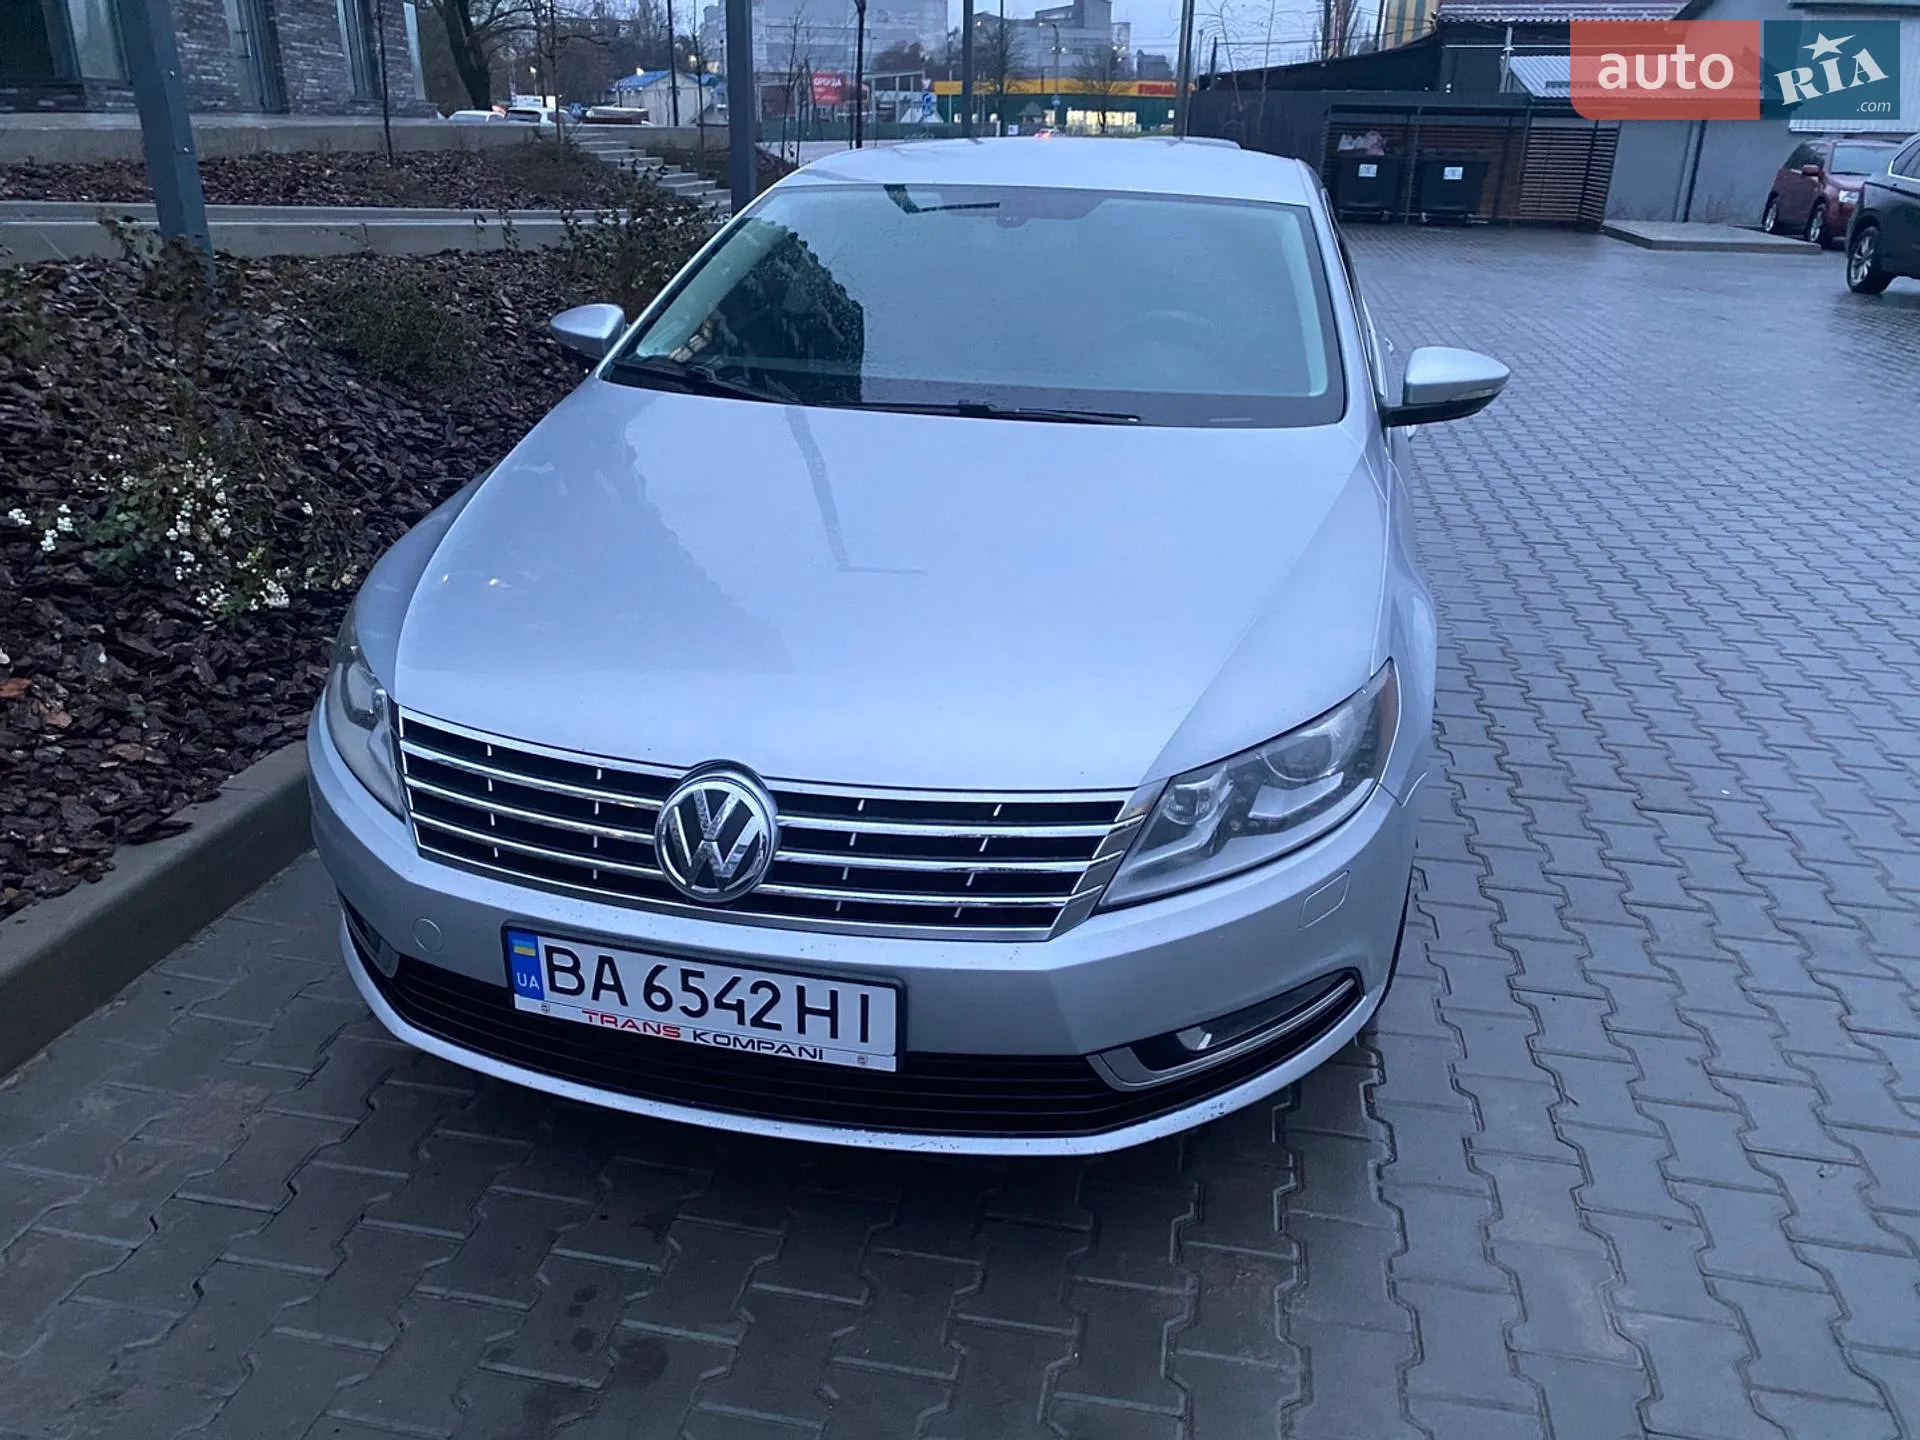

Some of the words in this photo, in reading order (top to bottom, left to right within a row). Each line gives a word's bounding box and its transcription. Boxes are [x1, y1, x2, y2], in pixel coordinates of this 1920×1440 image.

[666, 789, 762, 891] VW
[517, 971, 540, 990] UA
[582, 1010, 681, 1038] TRANS
[692, 1029, 823, 1060] KOMPANI
